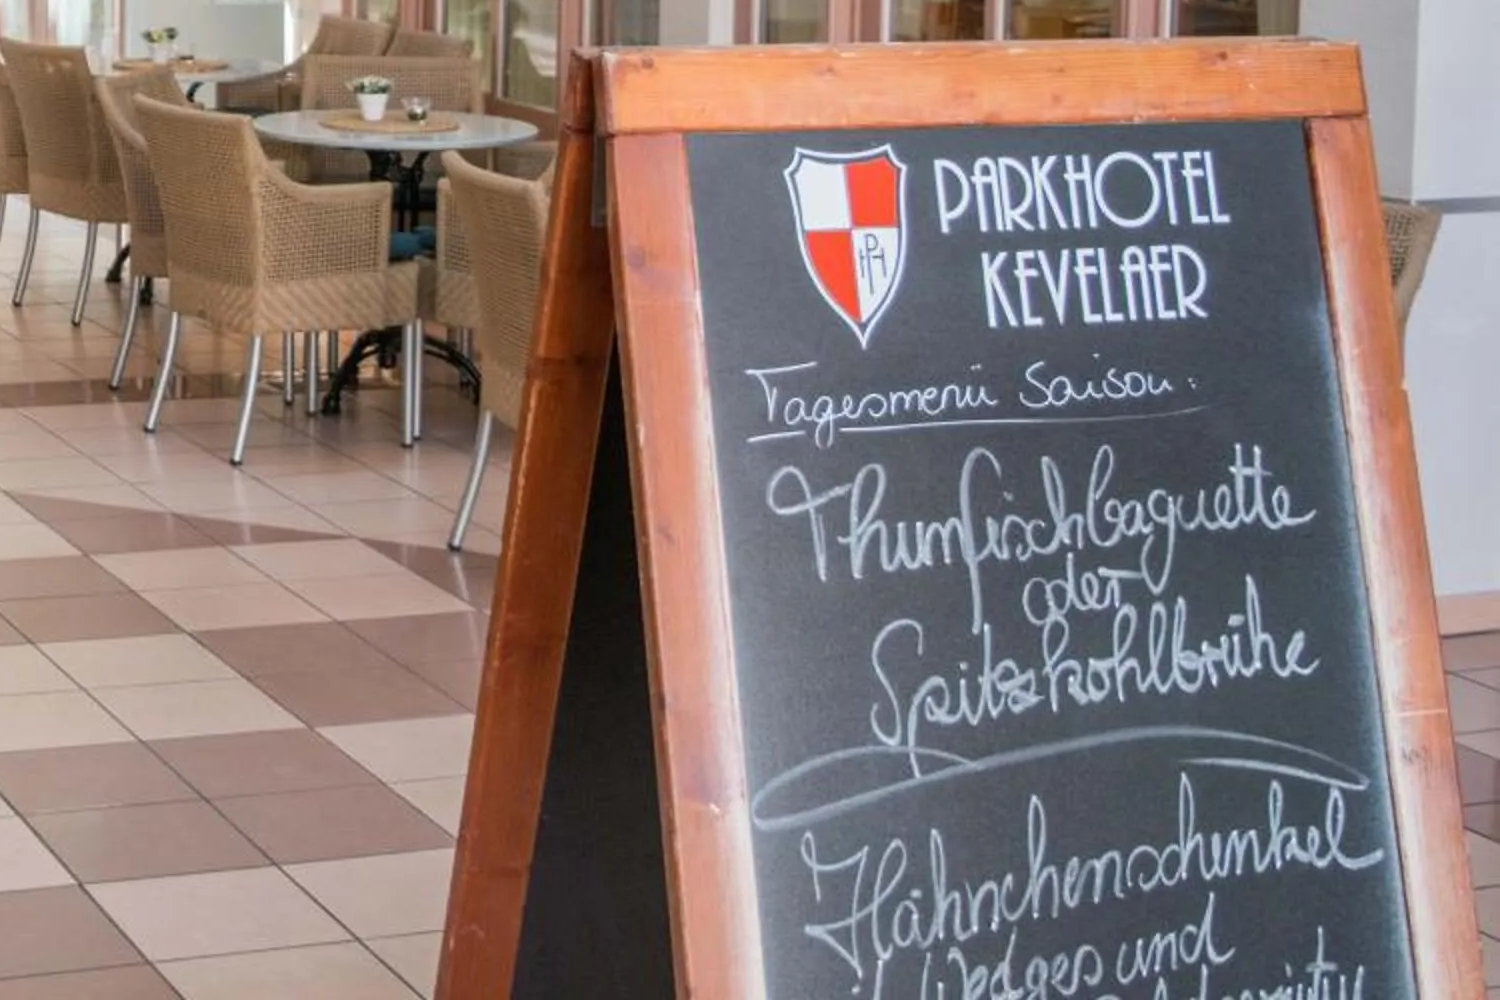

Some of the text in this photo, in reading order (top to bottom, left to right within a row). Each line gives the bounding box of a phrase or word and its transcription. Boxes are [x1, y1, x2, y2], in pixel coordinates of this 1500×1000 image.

[933, 150, 1232, 234] PARKHOTEL
[981, 243, 1209, 329] KEVELAER
[745, 360, 999, 449] Tagesmenü
[764, 442, 1319, 632] Thunfischbaguette
[1021, 552, 1142, 628] oder
[868, 574, 1320, 778] Spitzkohlbrühe
[800, 770, 1385, 977] Hähnchenschenkel
[1116, 890, 1238, 985] und
